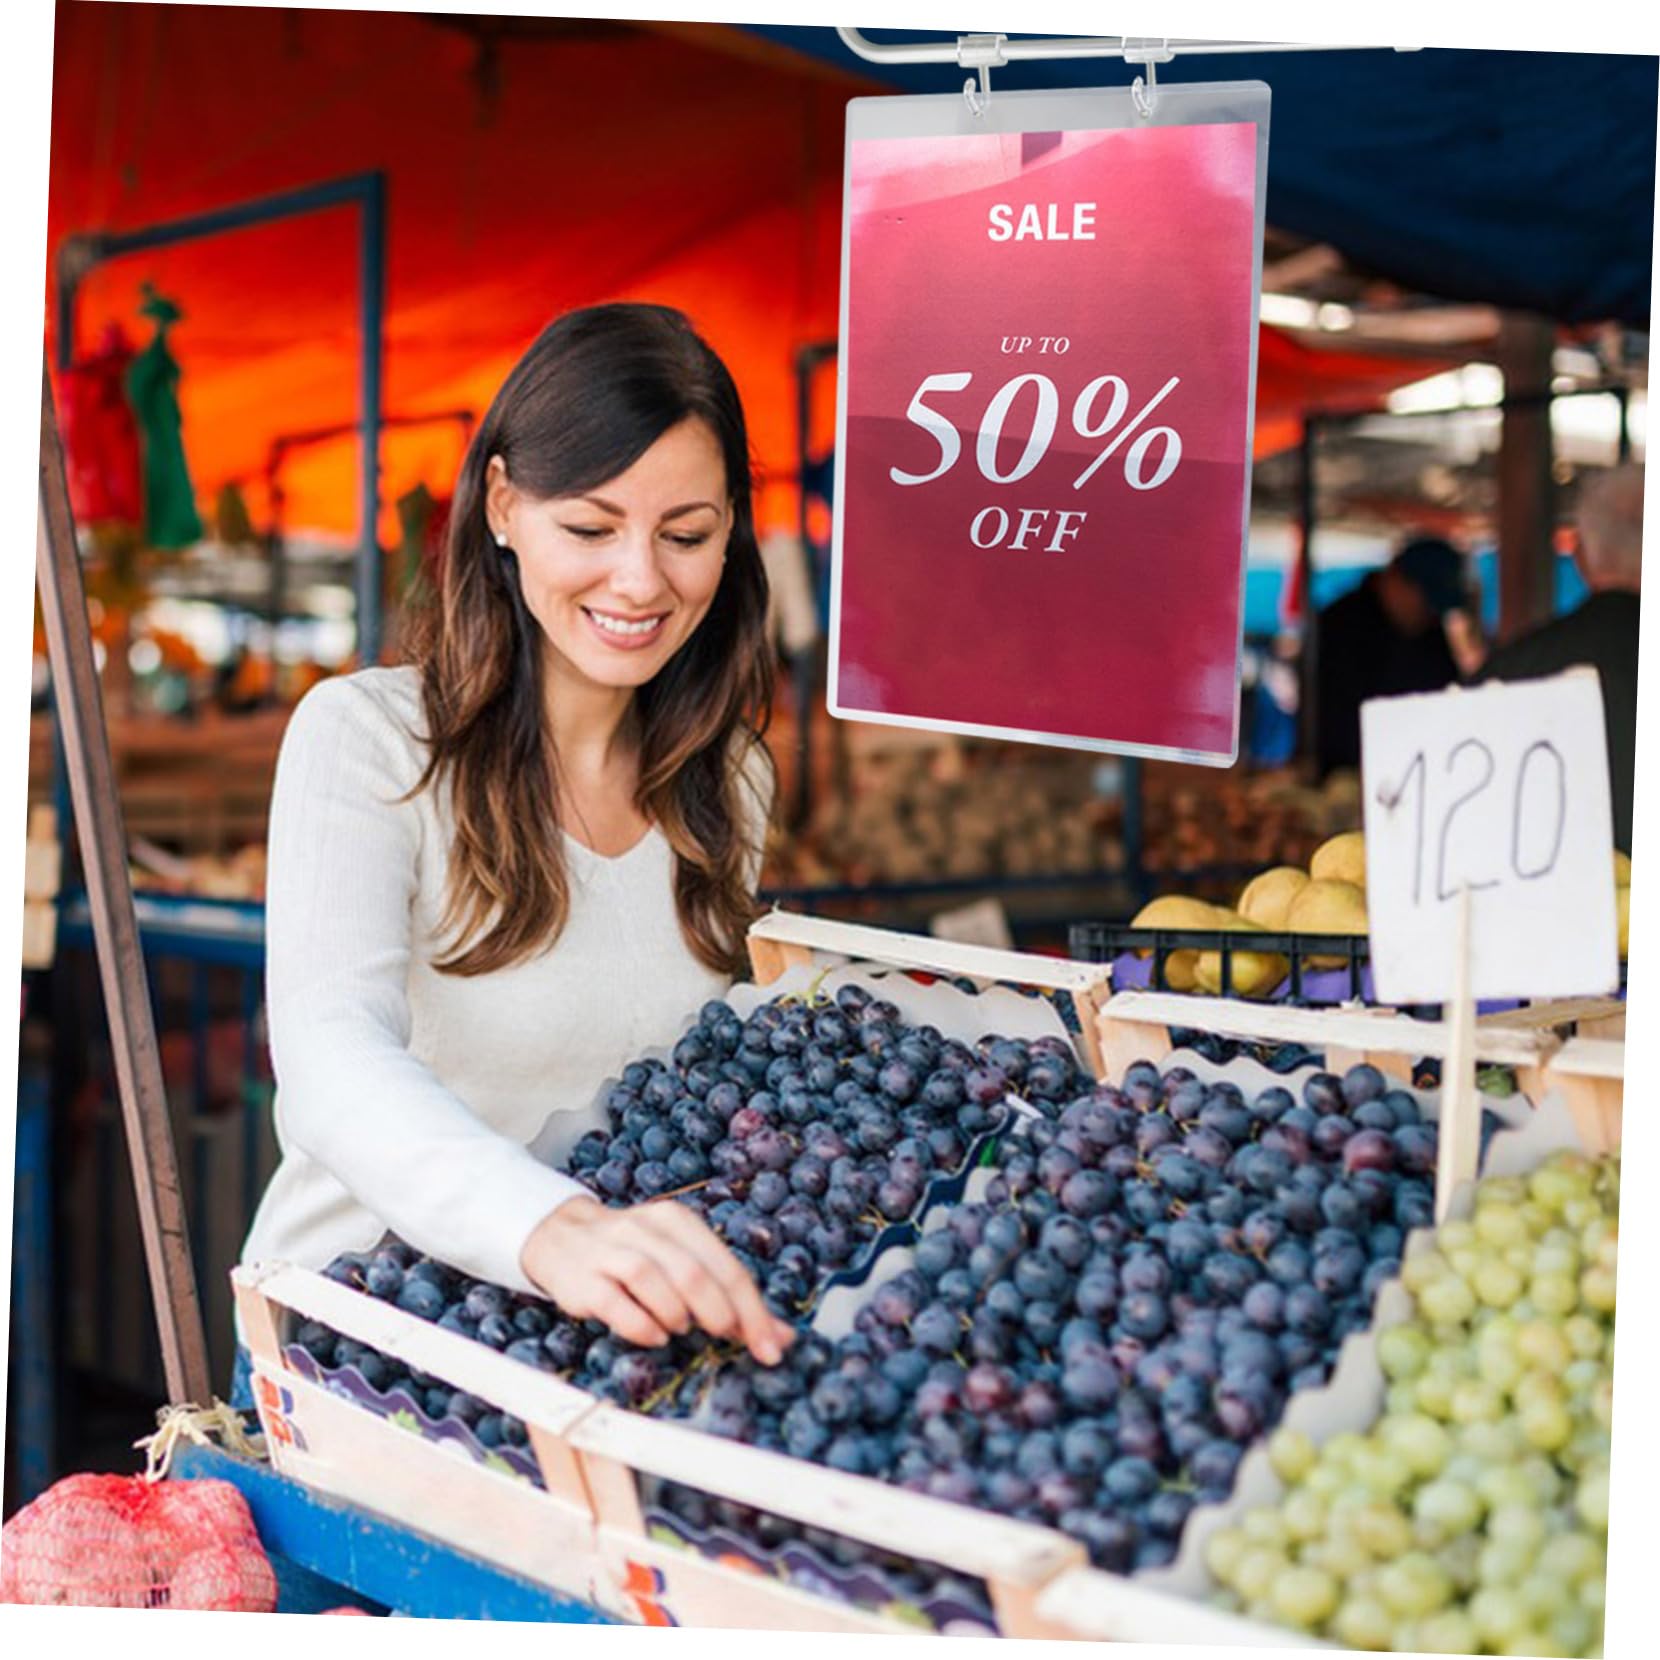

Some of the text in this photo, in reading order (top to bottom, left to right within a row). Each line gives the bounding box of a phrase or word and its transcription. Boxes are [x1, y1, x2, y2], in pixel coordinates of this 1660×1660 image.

[988, 202, 1097, 242] SALE
[1000, 336, 1070, 355] UP TO
[889, 371, 1182, 491] 50%
[969, 506, 1087, 553] OFF
[1376, 738, 1566, 905] 120
